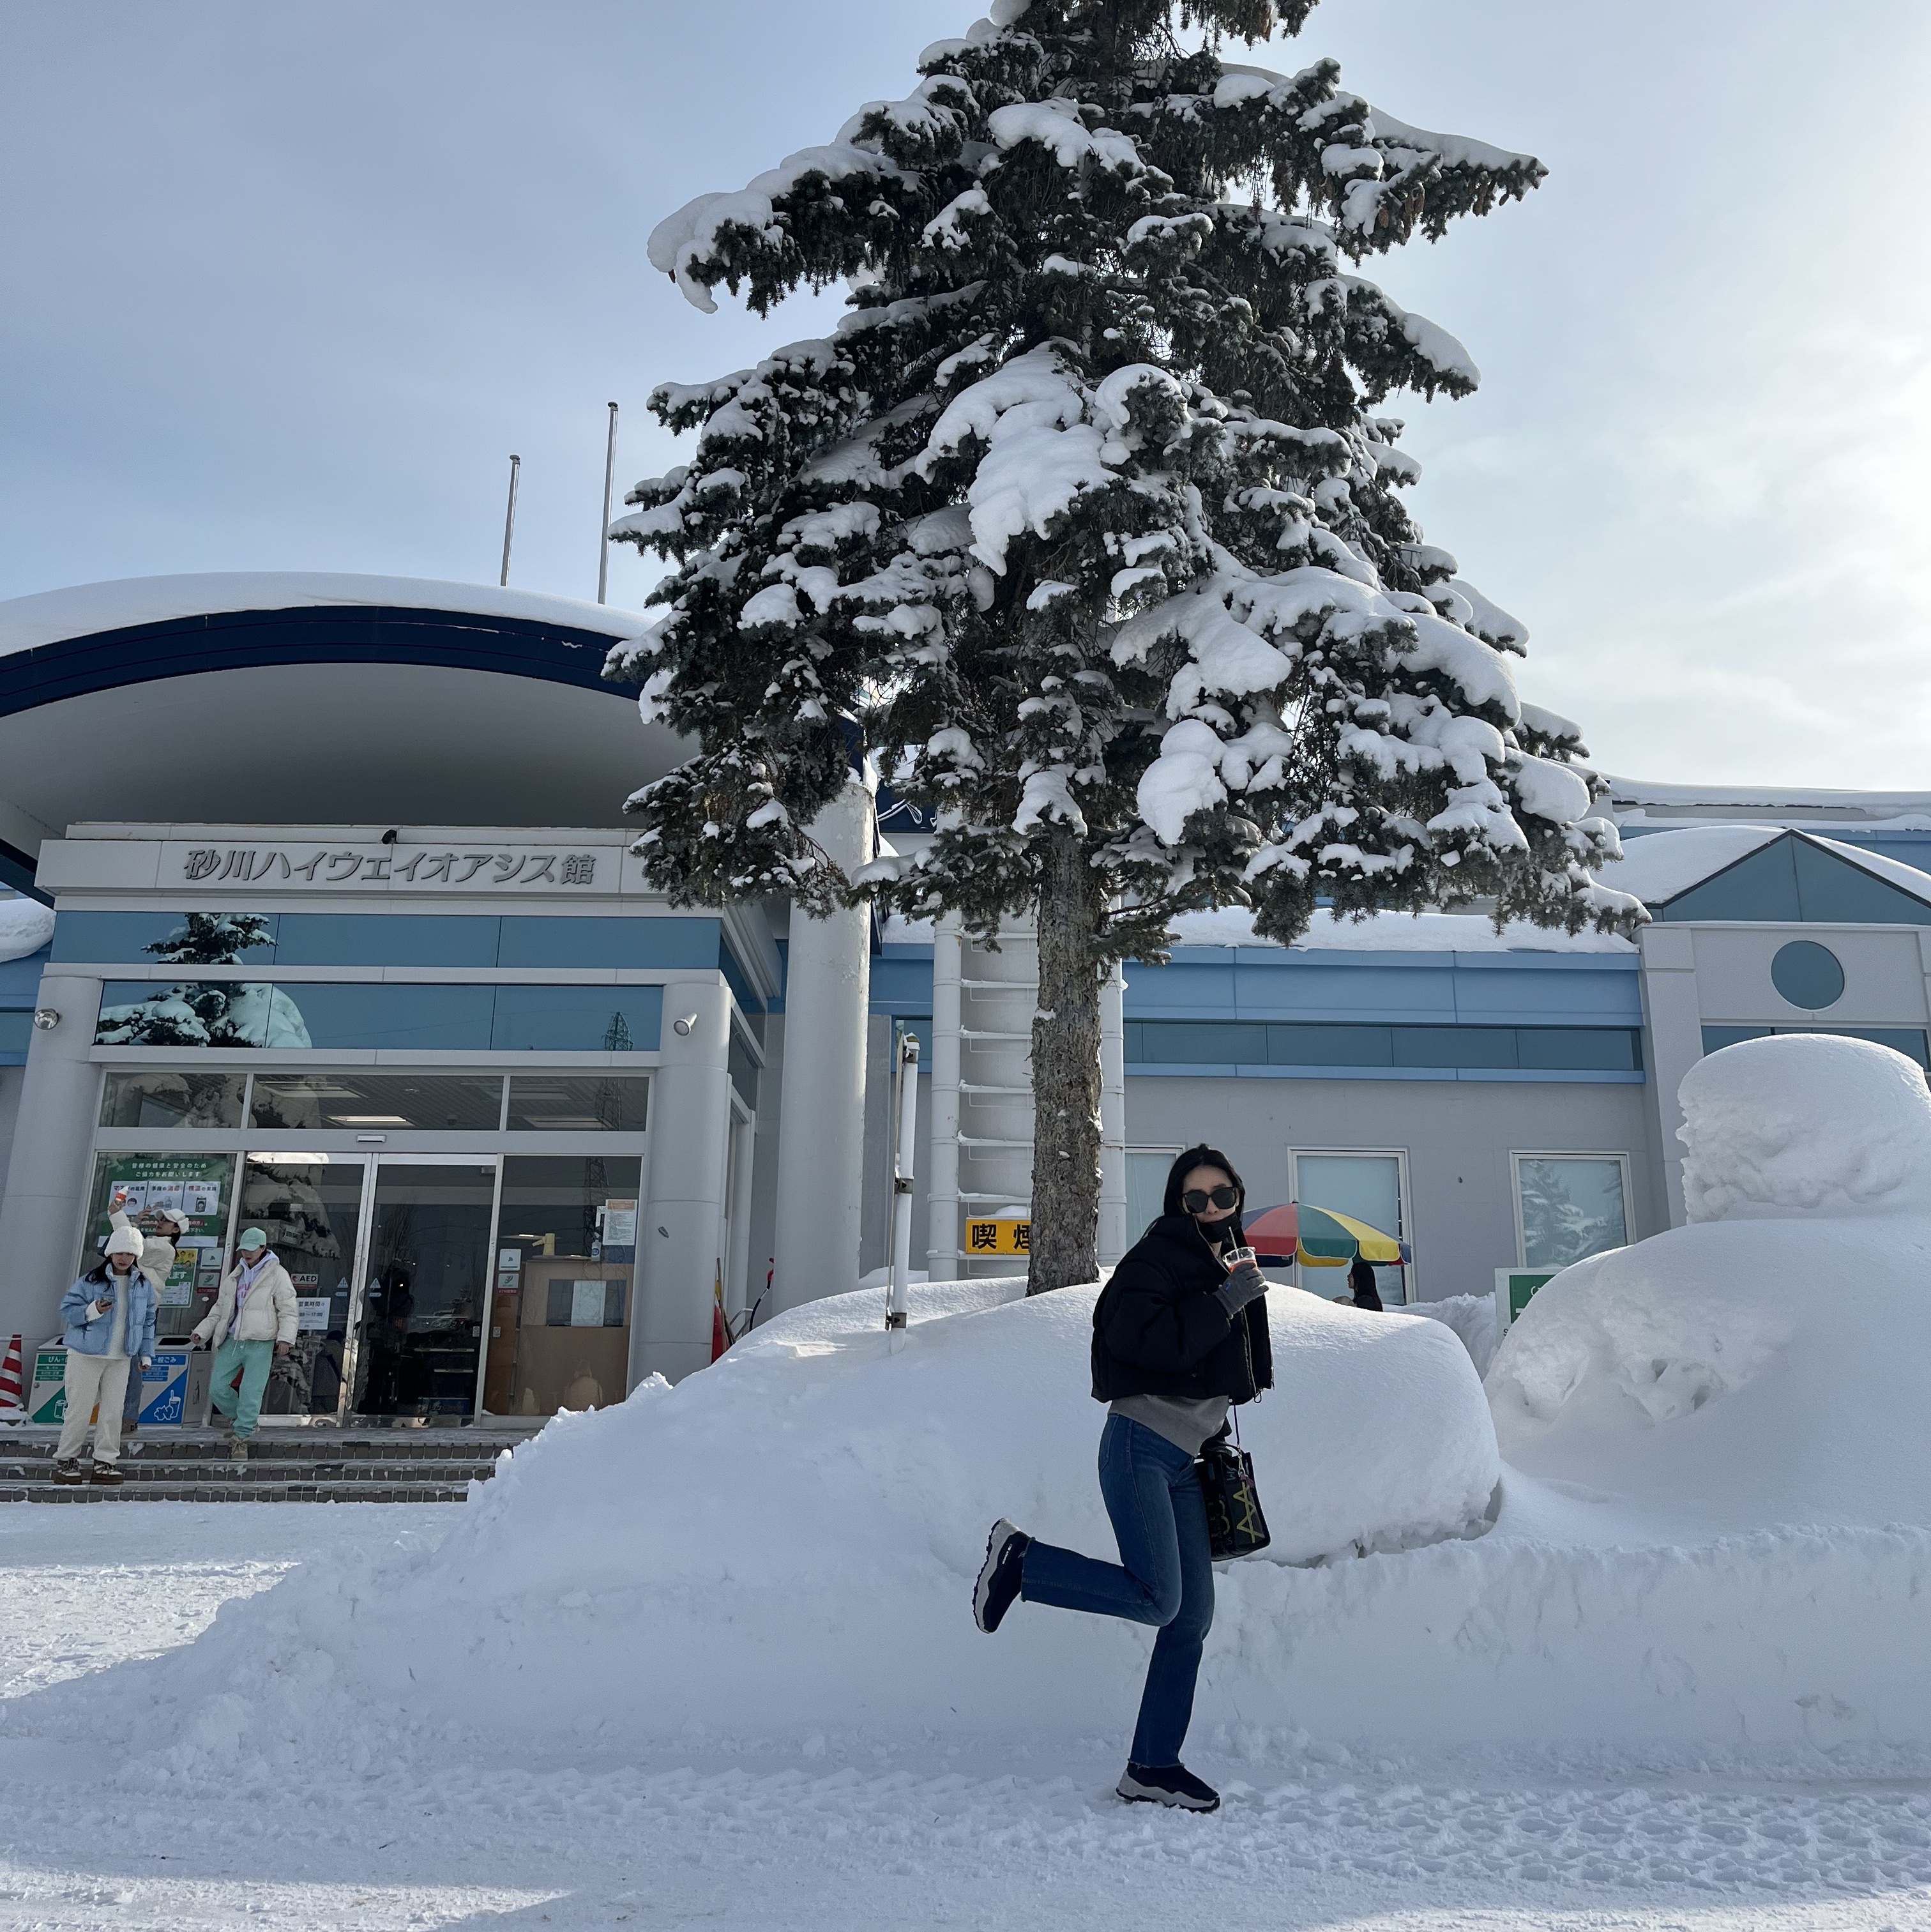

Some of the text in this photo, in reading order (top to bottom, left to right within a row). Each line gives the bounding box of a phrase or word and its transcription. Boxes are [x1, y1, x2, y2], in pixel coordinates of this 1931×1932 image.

[184, 849, 596, 885] 砂川ハイウェイオアシス館
